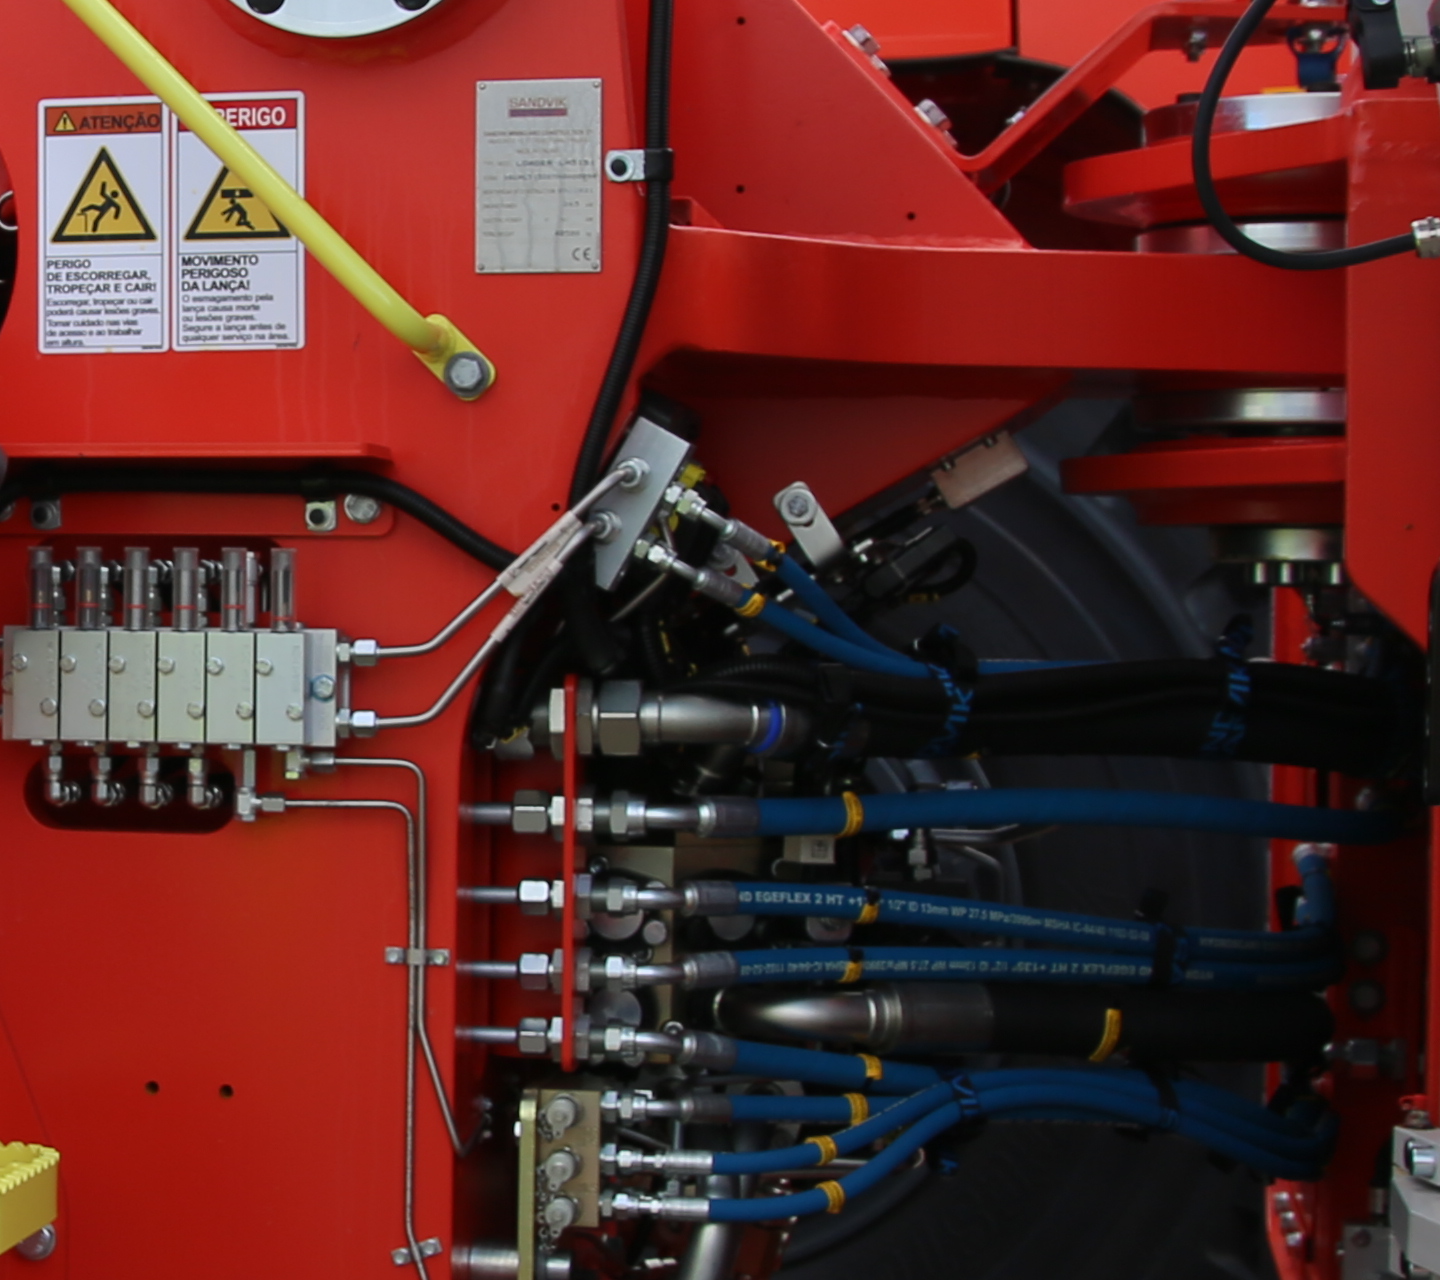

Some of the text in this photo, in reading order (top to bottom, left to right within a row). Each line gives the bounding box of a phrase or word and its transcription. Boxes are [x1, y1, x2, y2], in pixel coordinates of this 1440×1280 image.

[509, 97, 567, 108] SANDVIK
[79, 112, 161, 130] ATENÇÃO
[219, 106, 286, 126] PERIGO
[182, 255, 258, 266] MOVIMENTO
[572, 247, 591, 261] CE
[47, 259, 91, 269] PERIGO
[47, 270, 151, 281] DE ESCORREGAR,
[182, 267, 248, 279] PERIGOSO
[47, 282, 157, 295] TROPEÇAR E CAIR!
[182, 280, 250, 293] DA LANÇA!
[754, 891, 811, 904] EGEFLEX
[814, 893, 823, 904] 2
[825, 893, 843, 905] HT
